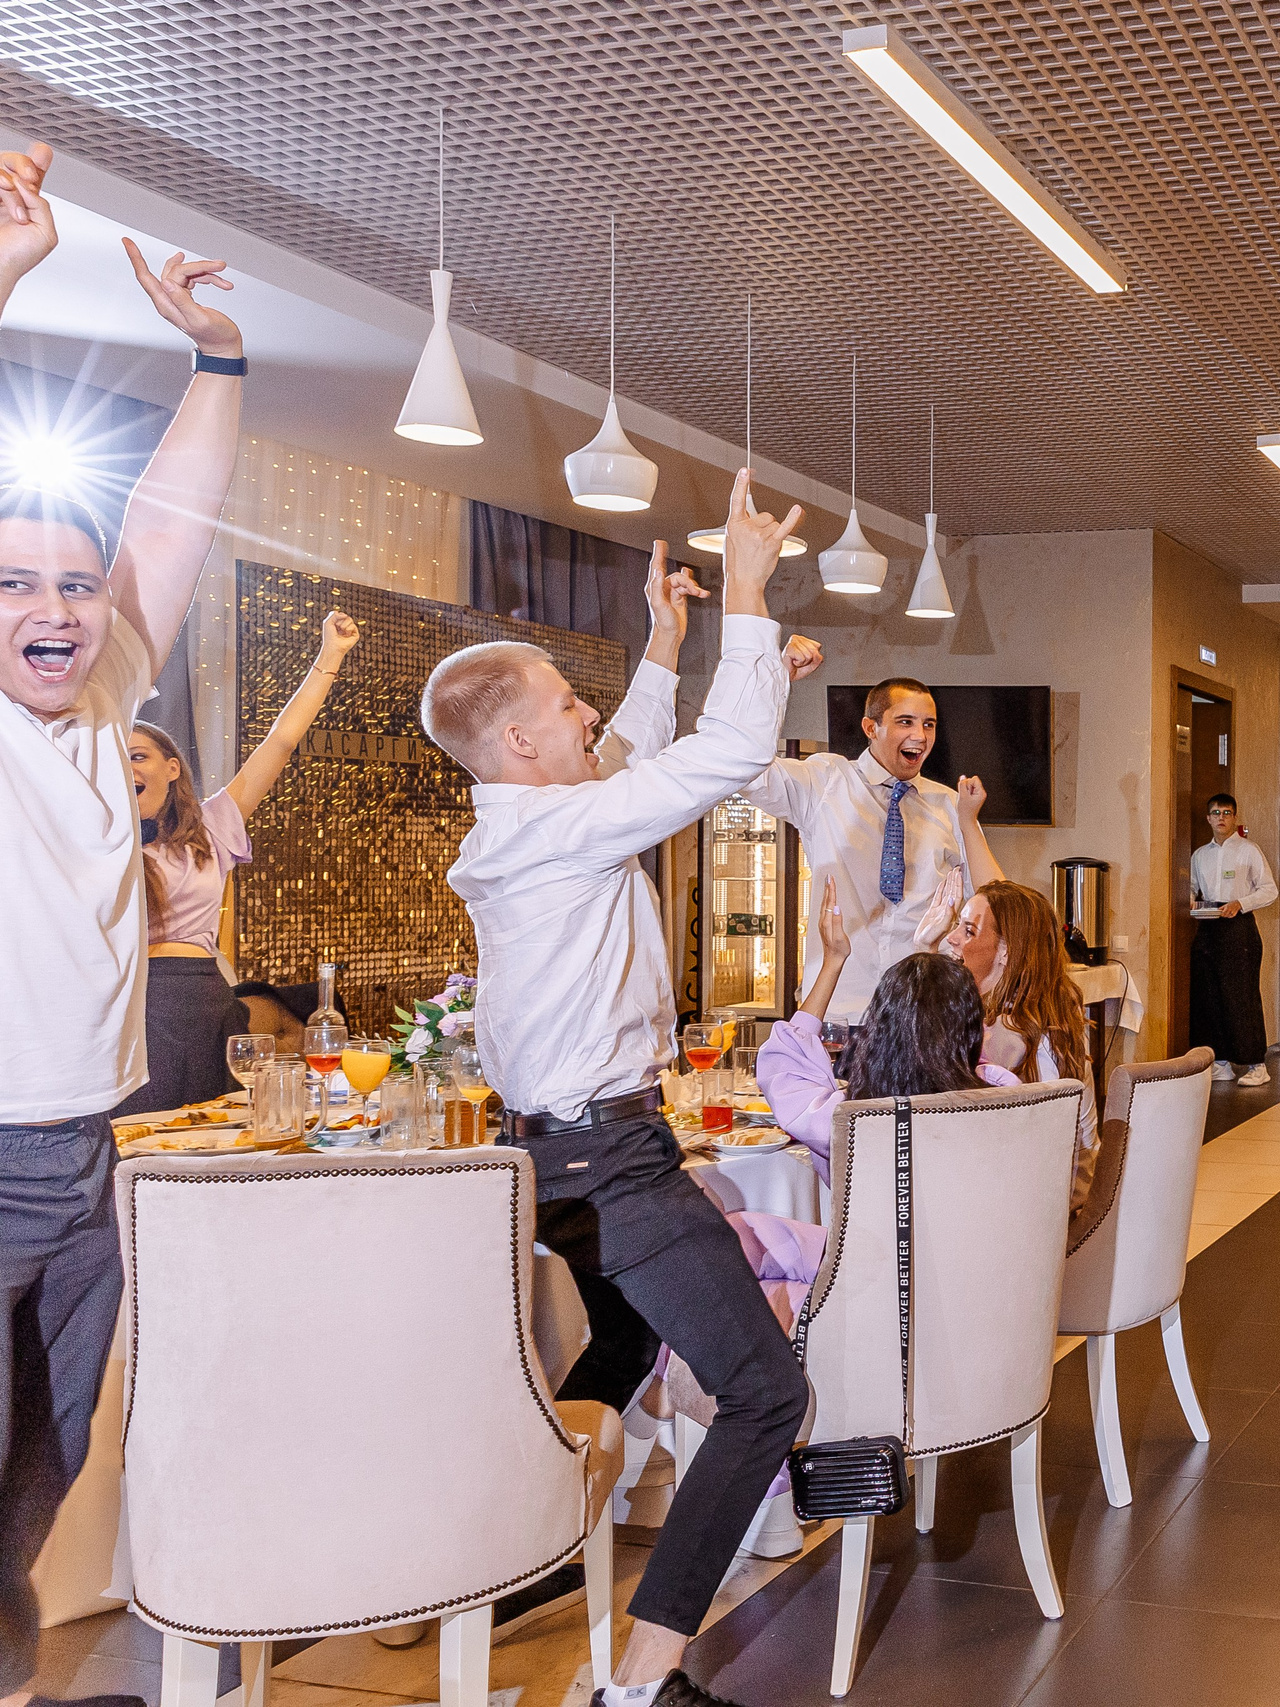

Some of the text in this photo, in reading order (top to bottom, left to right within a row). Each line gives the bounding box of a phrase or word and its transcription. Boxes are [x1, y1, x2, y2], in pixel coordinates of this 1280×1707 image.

[306, 729, 417, 760] КАСАРГИ
[897, 1121, 910, 1168] BETTER
[897, 1171, 910, 1228] FOREVER
[899, 1240, 909, 1347] FOREVER BETTER
[796, 1325, 806, 1361] BETT
